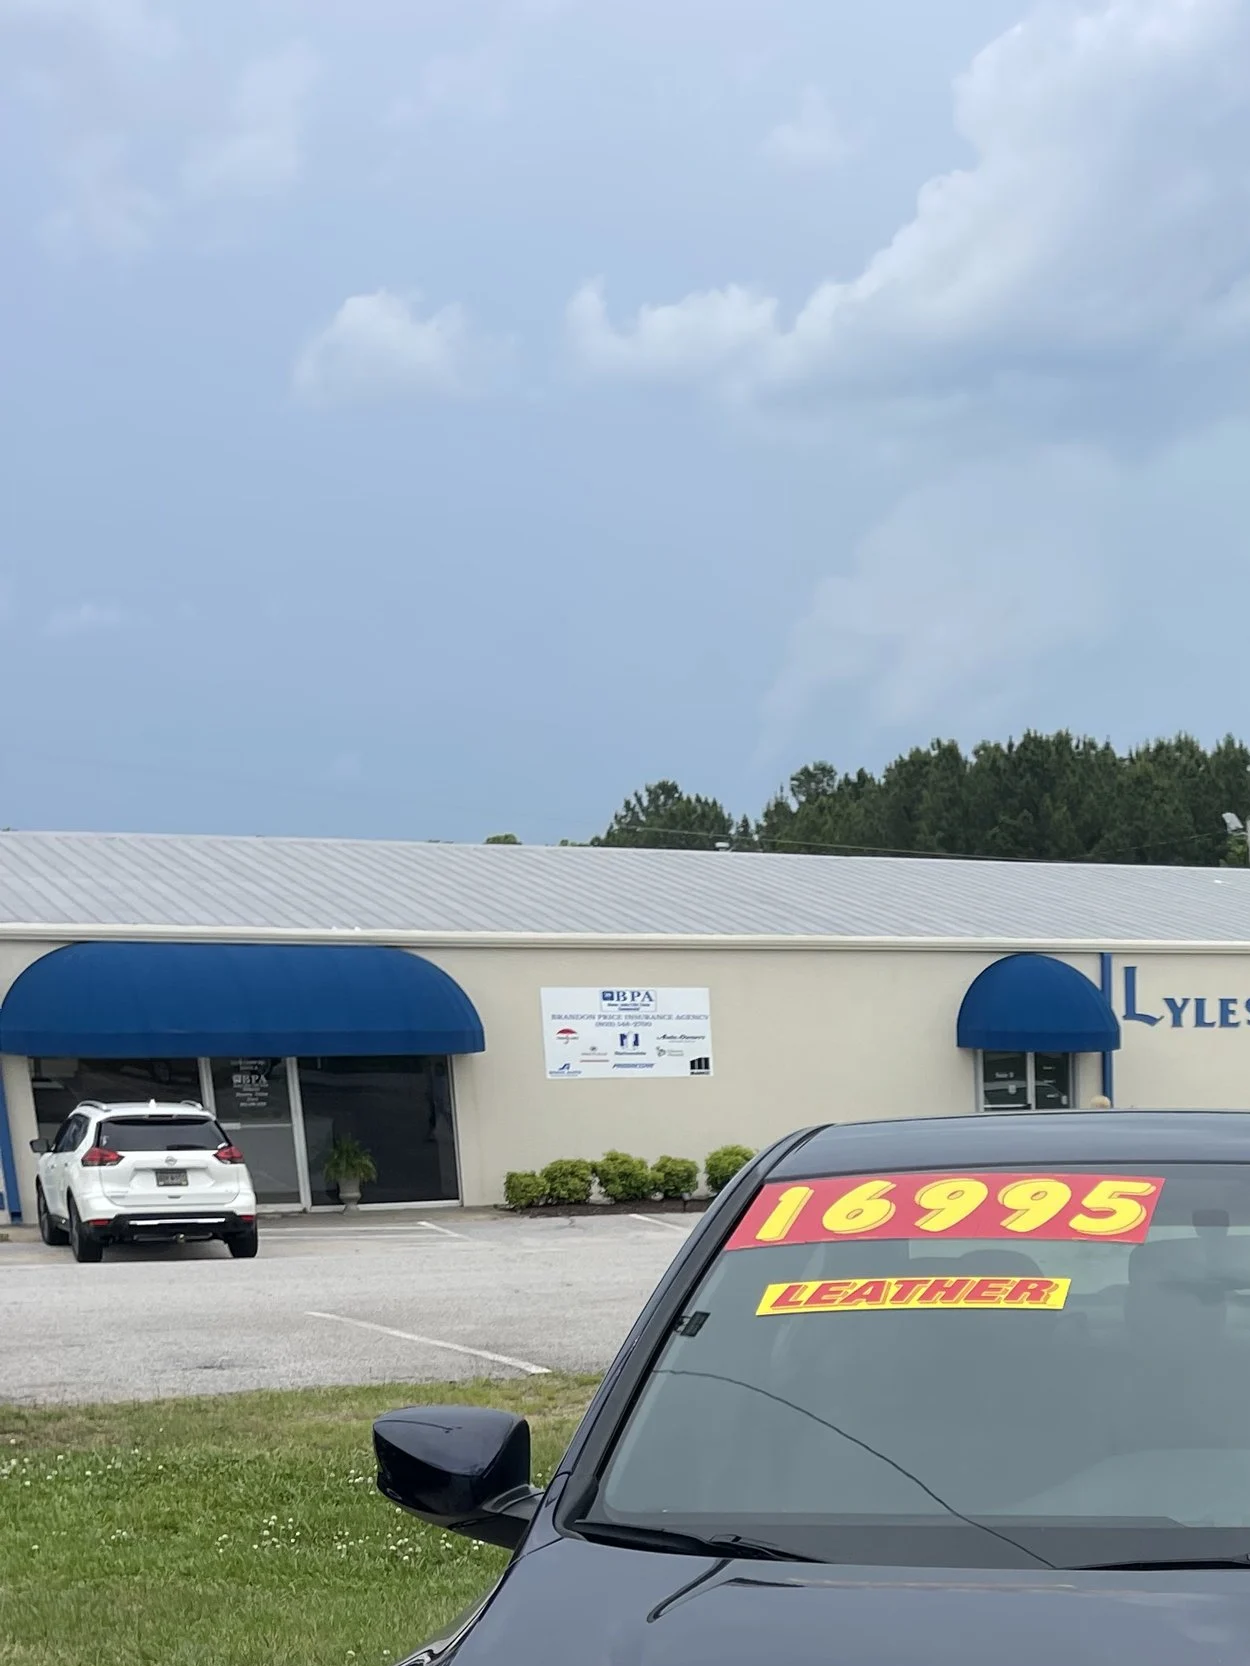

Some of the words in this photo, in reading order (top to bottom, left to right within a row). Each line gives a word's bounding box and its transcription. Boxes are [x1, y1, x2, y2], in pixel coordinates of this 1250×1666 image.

[615, 990, 653, 1002] BPA
[755, 1177, 1157, 1241] 16995
[770, 1278, 1059, 1310] LEATHER
